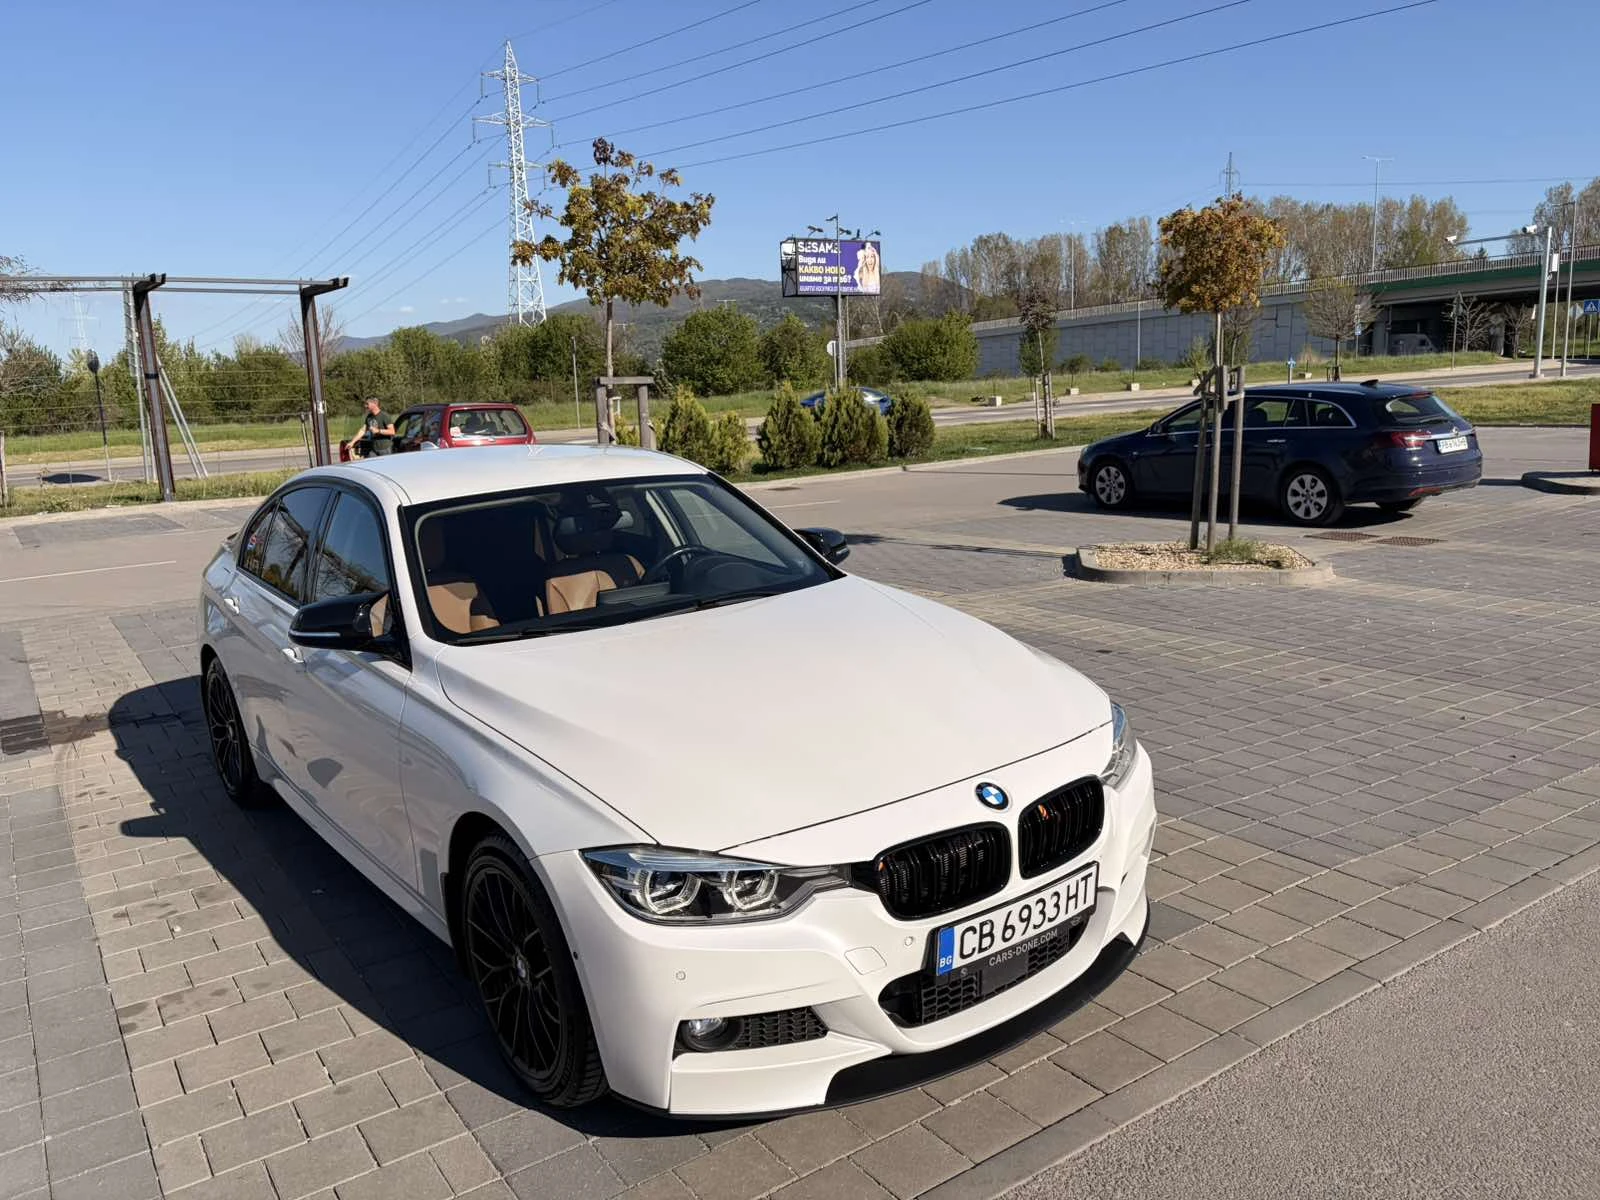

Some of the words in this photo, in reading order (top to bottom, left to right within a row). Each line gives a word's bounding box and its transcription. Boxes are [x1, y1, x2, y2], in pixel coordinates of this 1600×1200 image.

[798, 241, 841, 253] SESAME
[799, 265, 823, 274] КАКВО
[960, 919, 995, 960] CB
[1002, 892, 1060, 942] 6933
[1065, 872, 1093, 914] HT
[988, 928, 1058, 966] CARS-DONE.COM
[939, 955, 953, 968] BG
